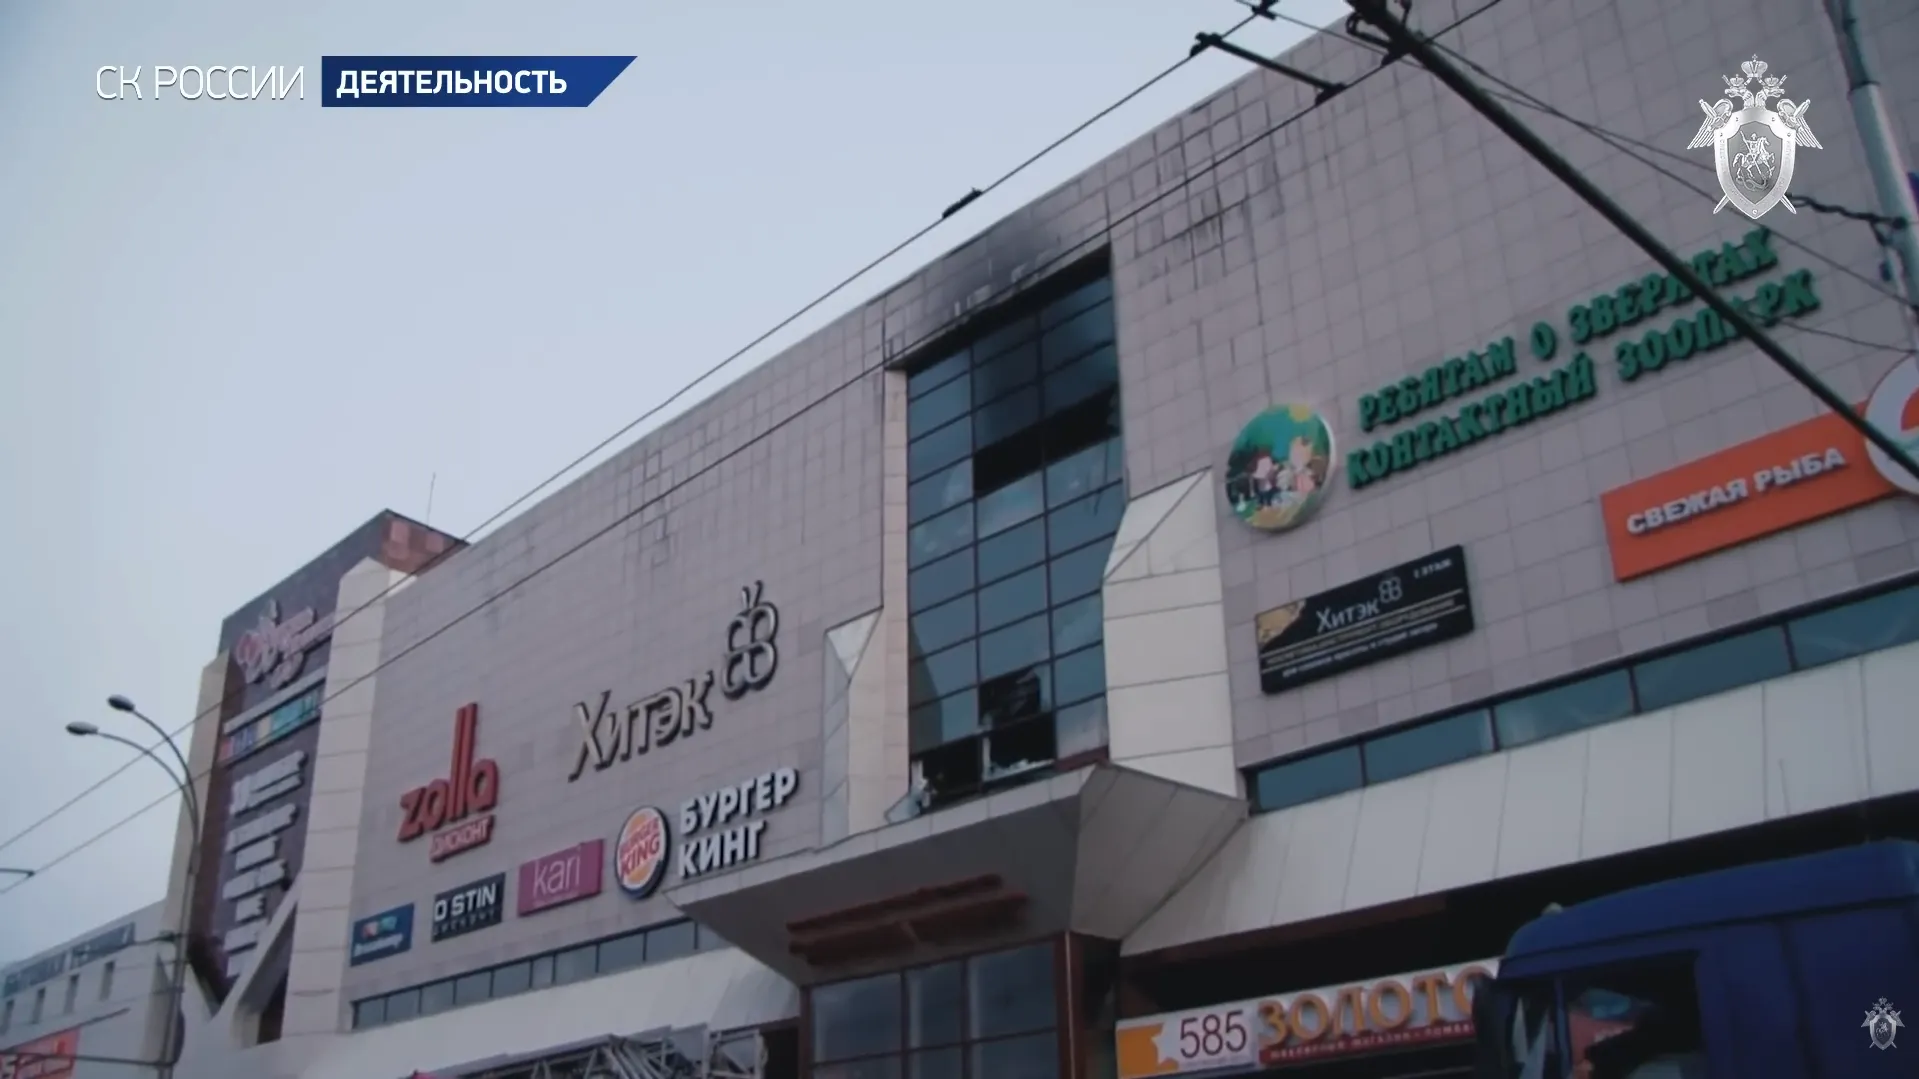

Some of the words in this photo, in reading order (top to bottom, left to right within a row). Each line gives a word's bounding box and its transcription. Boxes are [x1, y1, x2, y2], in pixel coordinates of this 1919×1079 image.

[1358, 336, 1516, 432] РЕБЯТАМ
[1531, 321, 1558, 361] О
[1347, 352, 1597, 489] КОНТАКТНЫЙ
[1626, 478, 1748, 534] СВЕЖАЯ
[1753, 448, 1847, 492] РЫБА
[398, 702, 498, 842] zolla
[680, 767, 798, 836] БУРГЕР
[679, 820, 765, 877] КИНГ
[1180, 1009, 1247, 1059] 585
